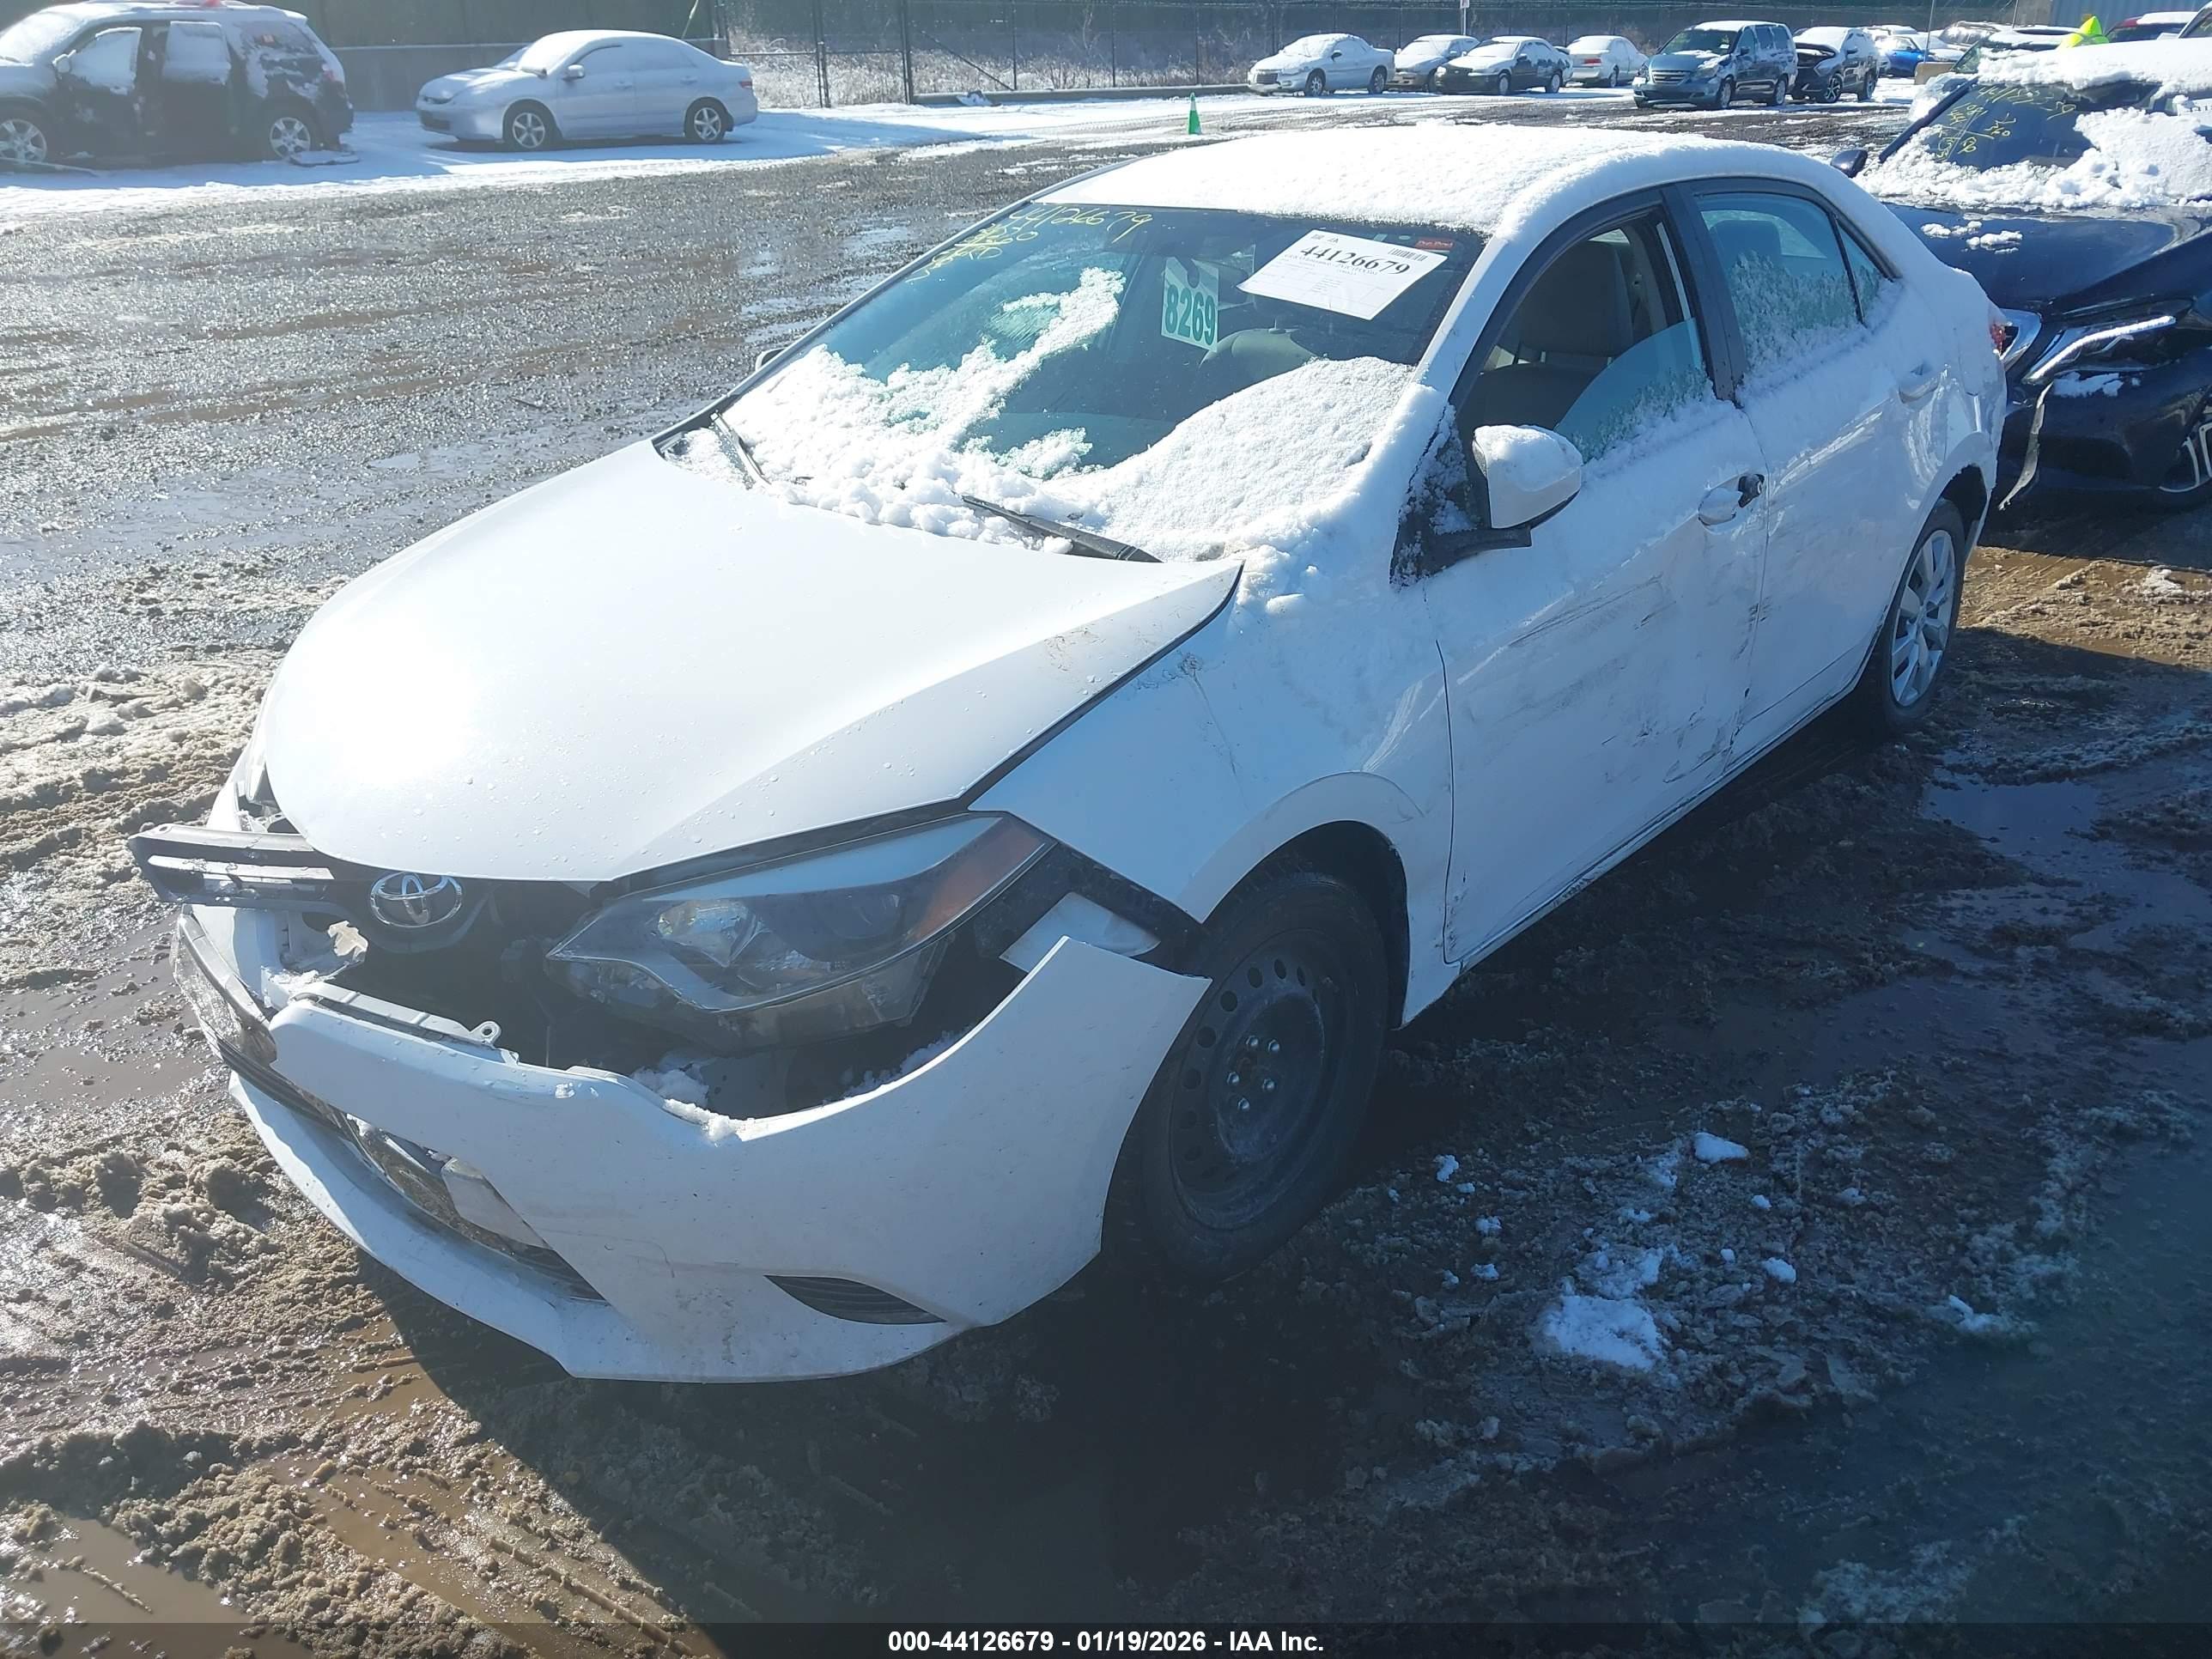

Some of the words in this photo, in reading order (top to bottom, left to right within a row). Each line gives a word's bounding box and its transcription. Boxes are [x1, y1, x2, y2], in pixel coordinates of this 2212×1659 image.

[1008, 204, 1154, 244] 44126679
[1300, 245, 1411, 275] 44126679
[1164, 284, 1216, 346] 8269
